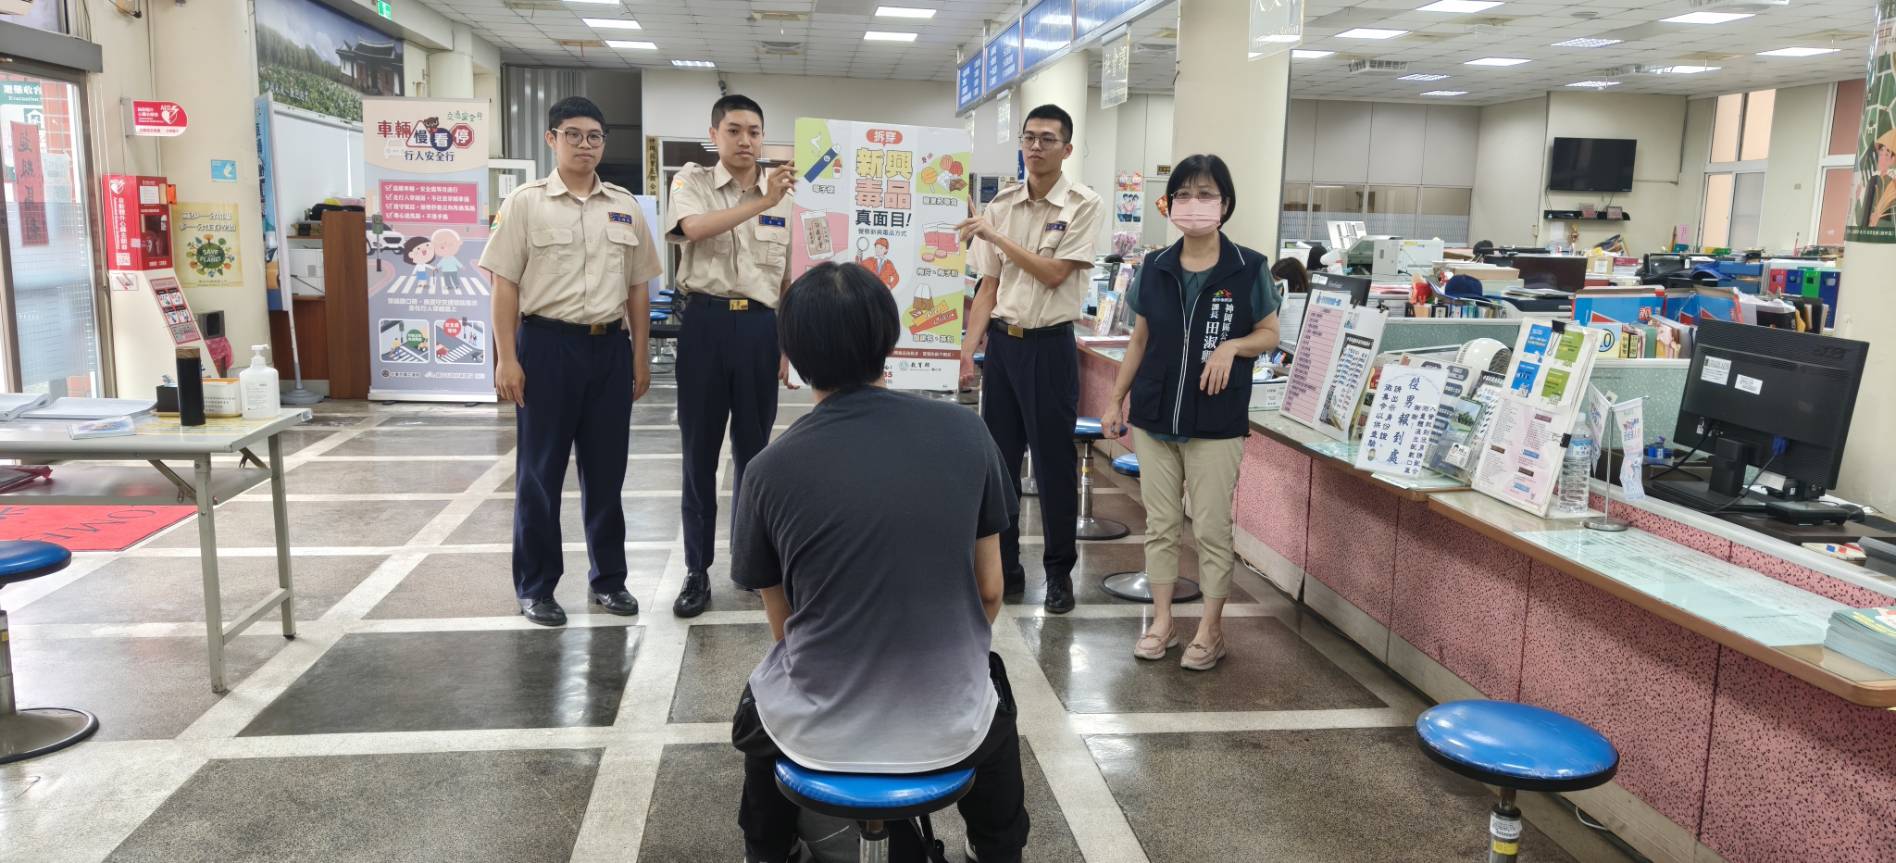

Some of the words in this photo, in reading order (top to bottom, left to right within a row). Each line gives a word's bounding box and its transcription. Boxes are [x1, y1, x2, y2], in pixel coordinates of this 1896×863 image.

[873, 130, 897, 143] 拆穿
[404, 150, 455, 162] 行人安全行
[856, 148, 913, 179] 新興
[855, 179, 912, 209] 毒品
[855, 209, 912, 228] 真面目!
